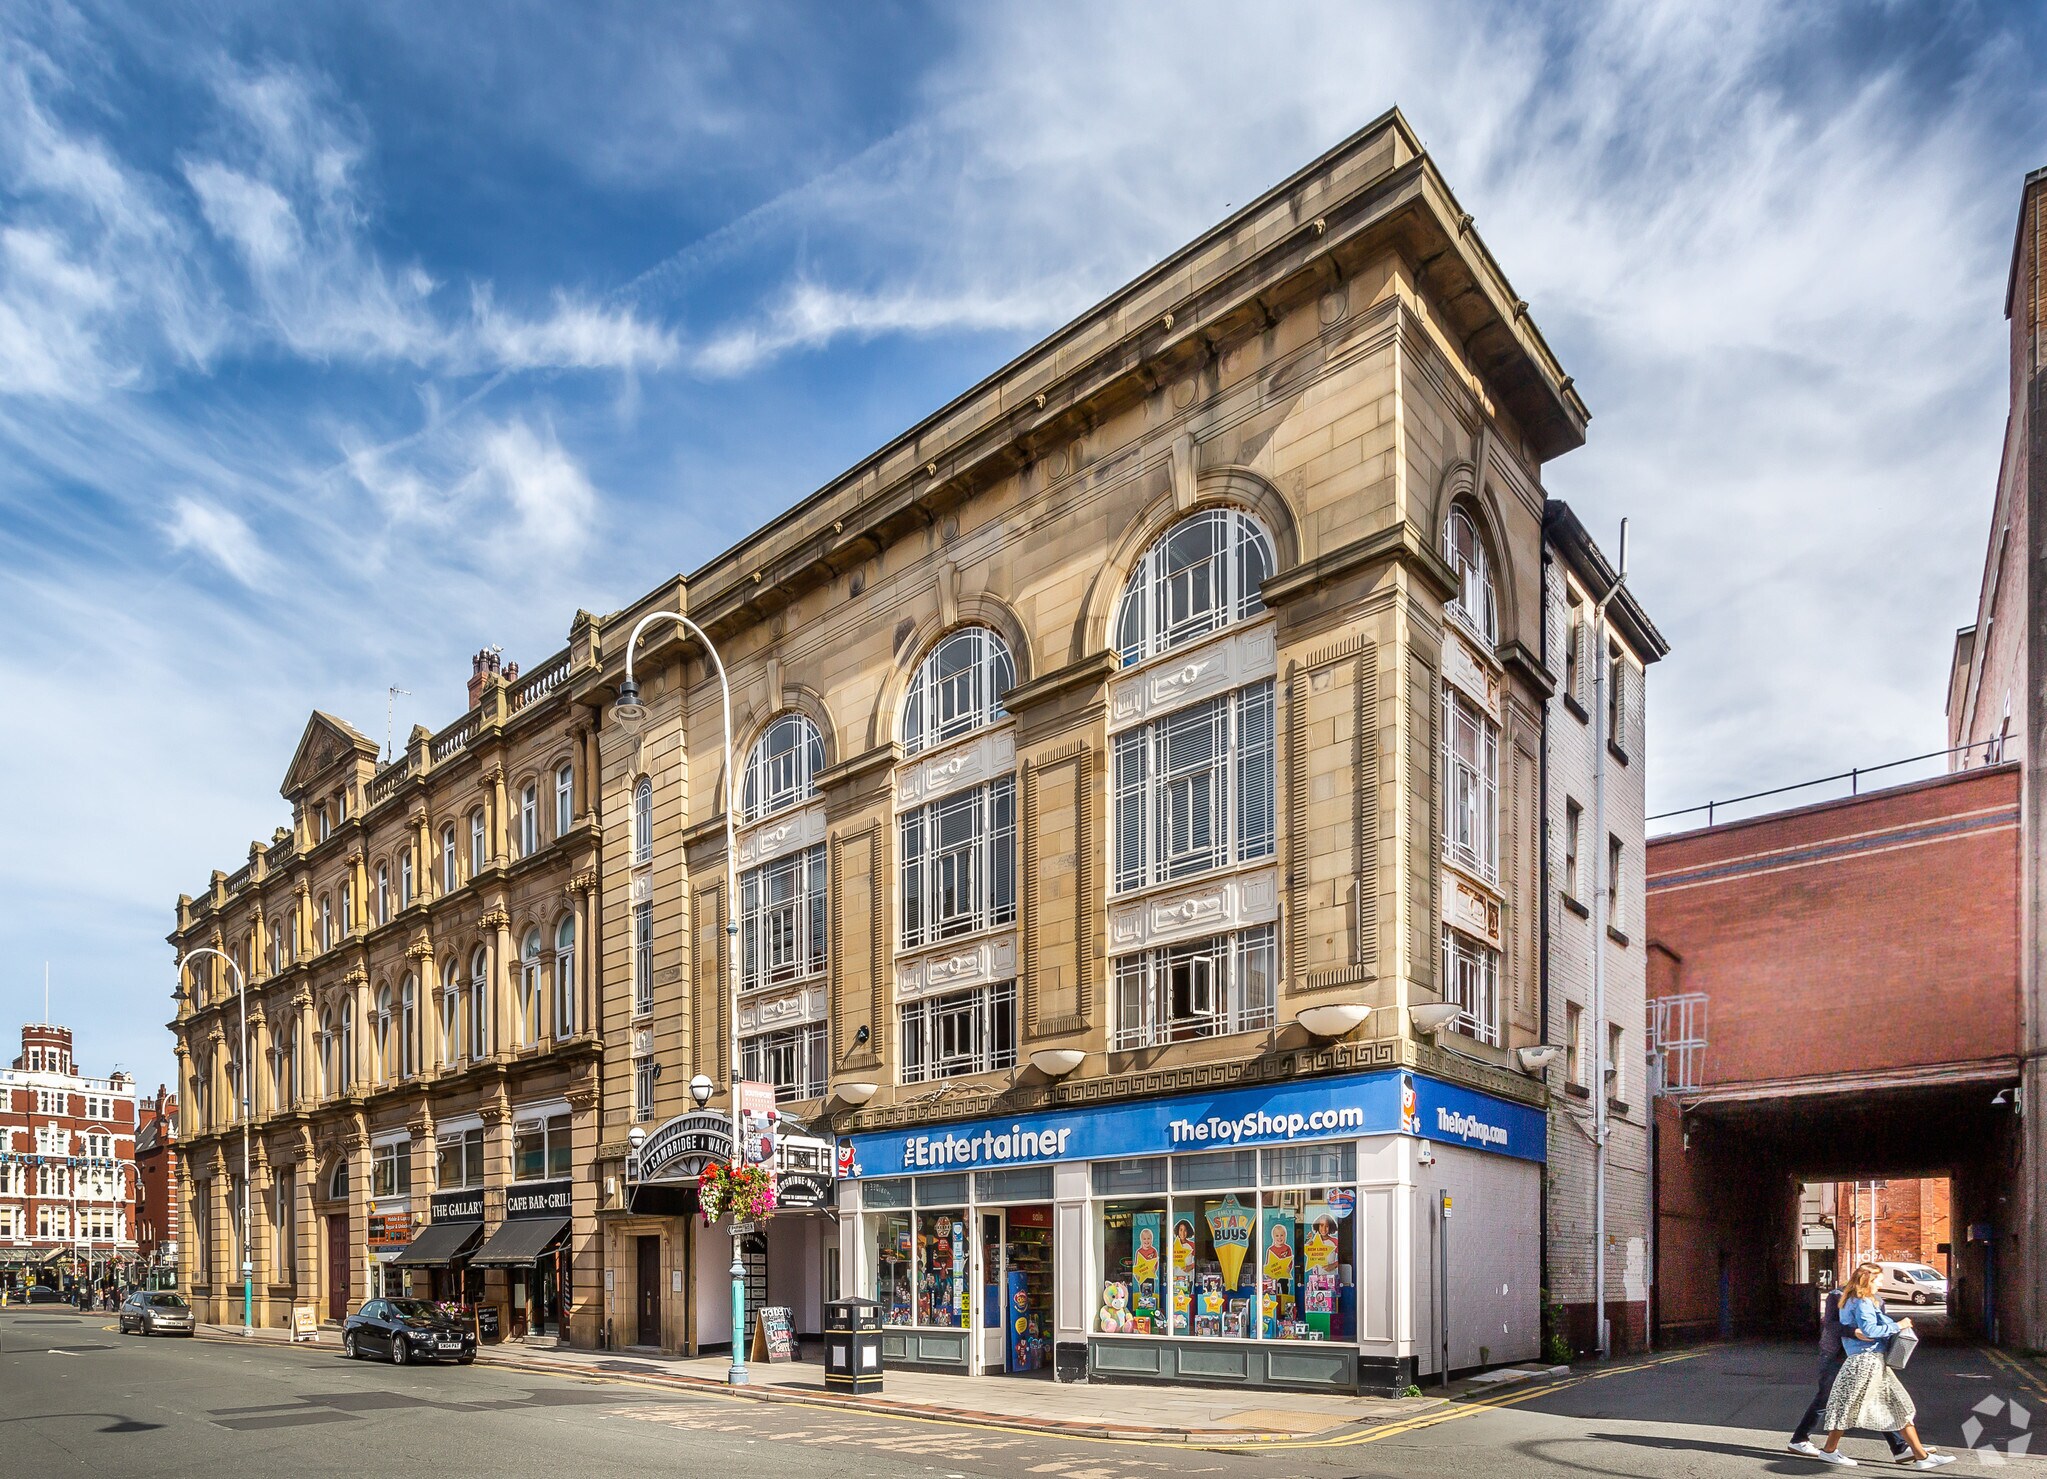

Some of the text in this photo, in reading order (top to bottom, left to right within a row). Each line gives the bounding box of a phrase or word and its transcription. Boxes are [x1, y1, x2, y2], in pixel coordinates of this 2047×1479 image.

[1170, 1107, 1363, 1142] TheToyShop.com
[1436, 1107, 1508, 1146] TheToyShop.com
[651, 1135, 697, 1168] CAMBRIDGE
[904, 1124, 1072, 1167] The Entertainer
[432, 1201, 484, 1218] THE GALLARY
[507, 1193, 572, 1212] CAFE BAR GRILL
[1213, 1215, 1248, 1229] STAR
[1214, 1229, 1248, 1241] BUYS
